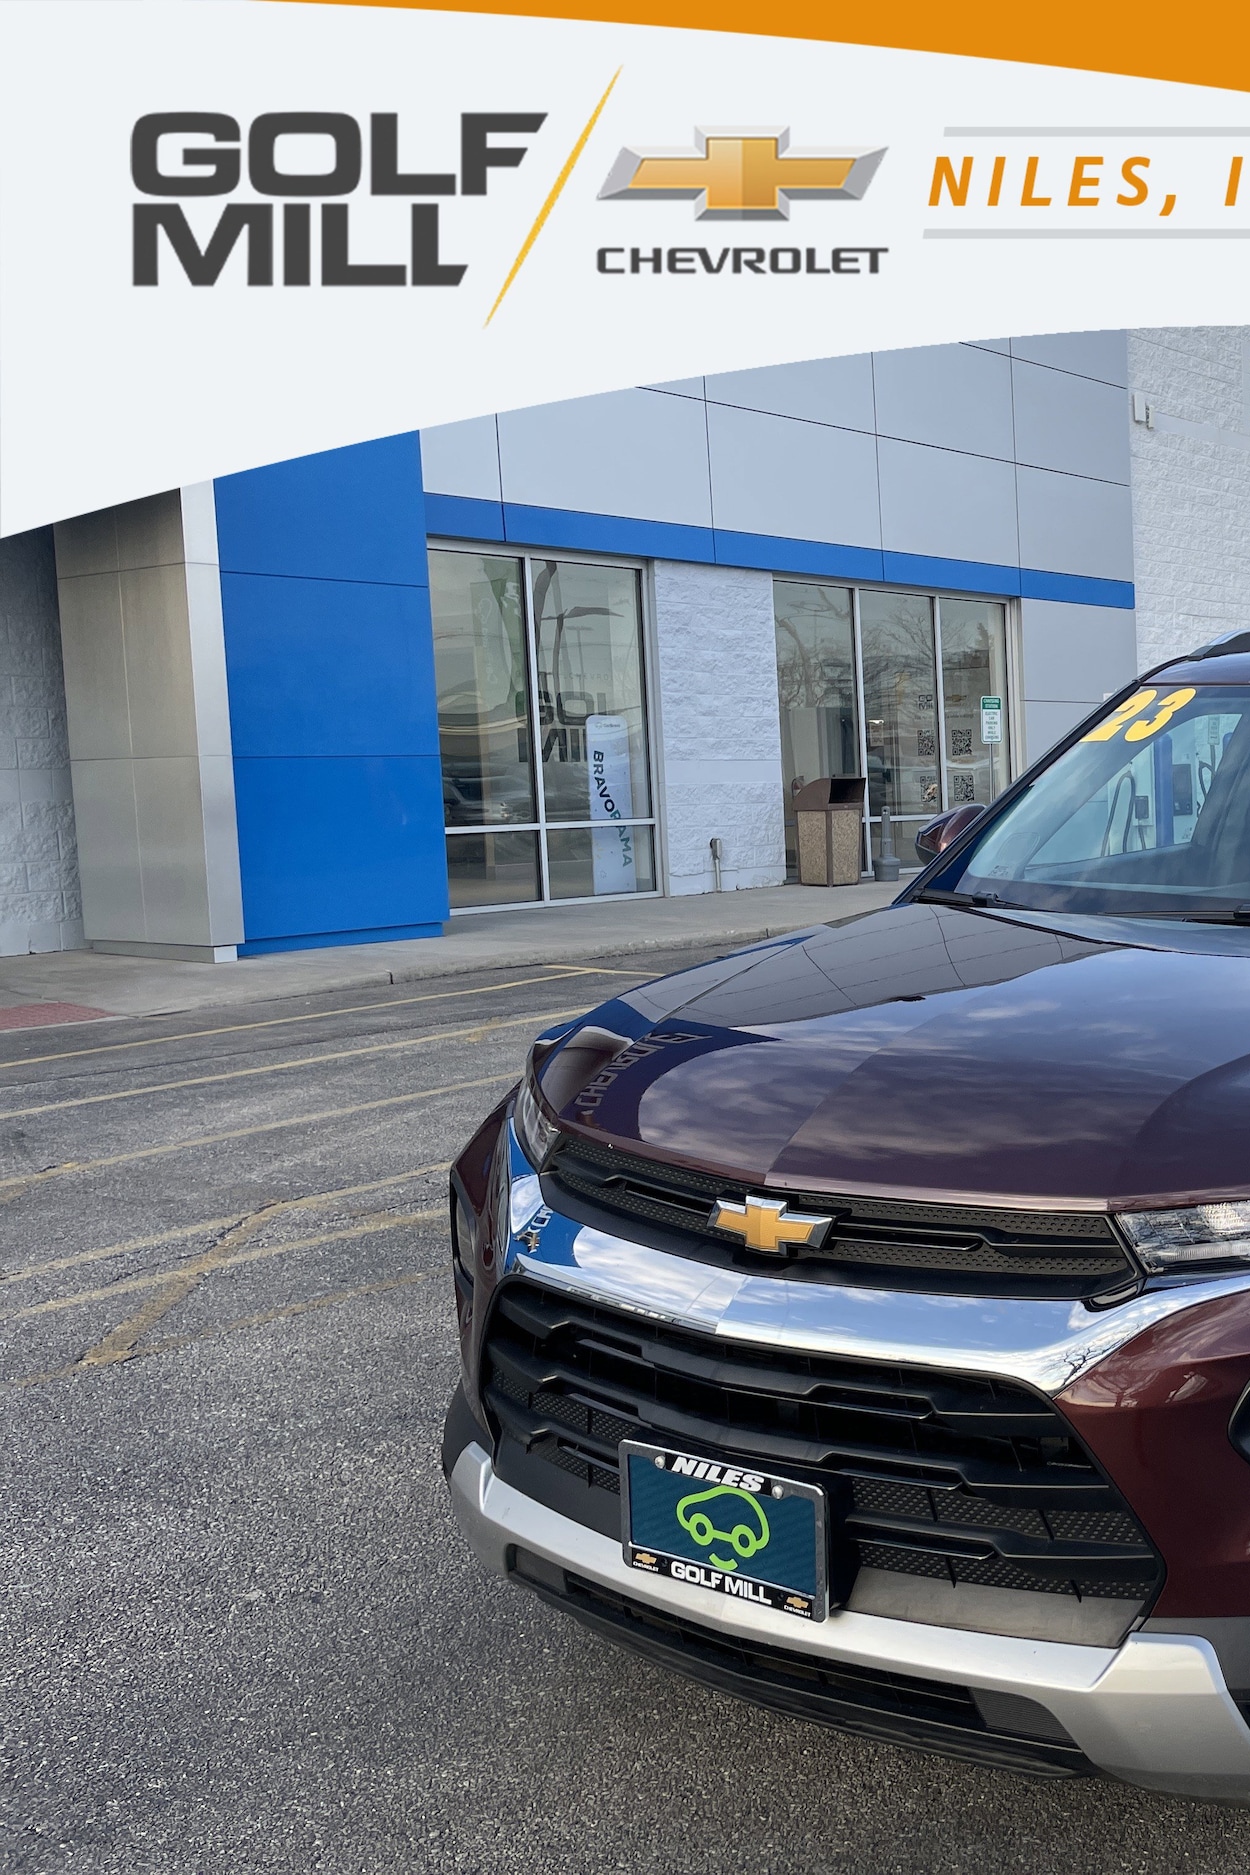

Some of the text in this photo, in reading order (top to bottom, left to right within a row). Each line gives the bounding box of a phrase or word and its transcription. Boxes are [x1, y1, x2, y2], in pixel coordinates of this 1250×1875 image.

[1078, 687, 1197, 742] 23
[671, 1456, 765, 1492] NILES
[670, 1560, 772, 1605] GOLF MILL
